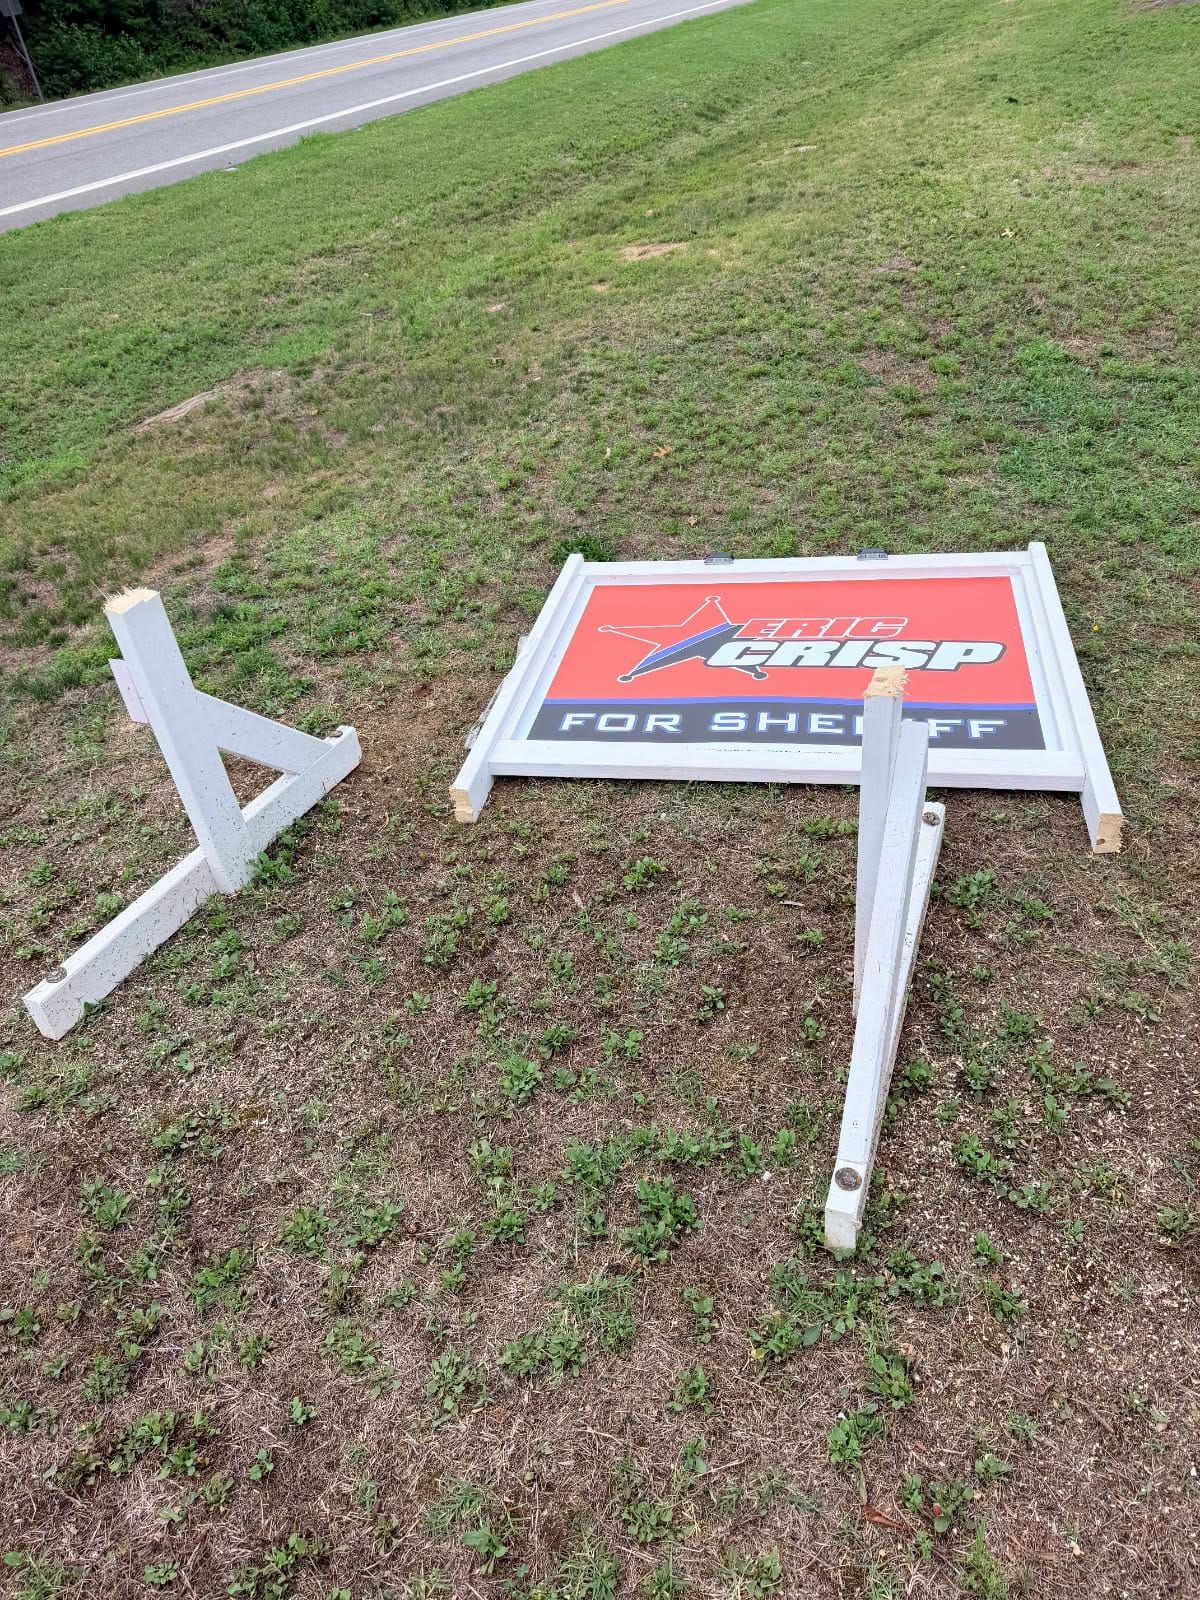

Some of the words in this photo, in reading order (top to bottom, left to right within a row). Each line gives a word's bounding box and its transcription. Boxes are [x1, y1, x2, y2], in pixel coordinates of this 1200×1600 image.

[733, 616, 908, 639] ERIC
[704, 639, 1007, 671] CRISP
[559, 712, 684, 734] FOR
[710, 711, 1007, 738] SHEFF
